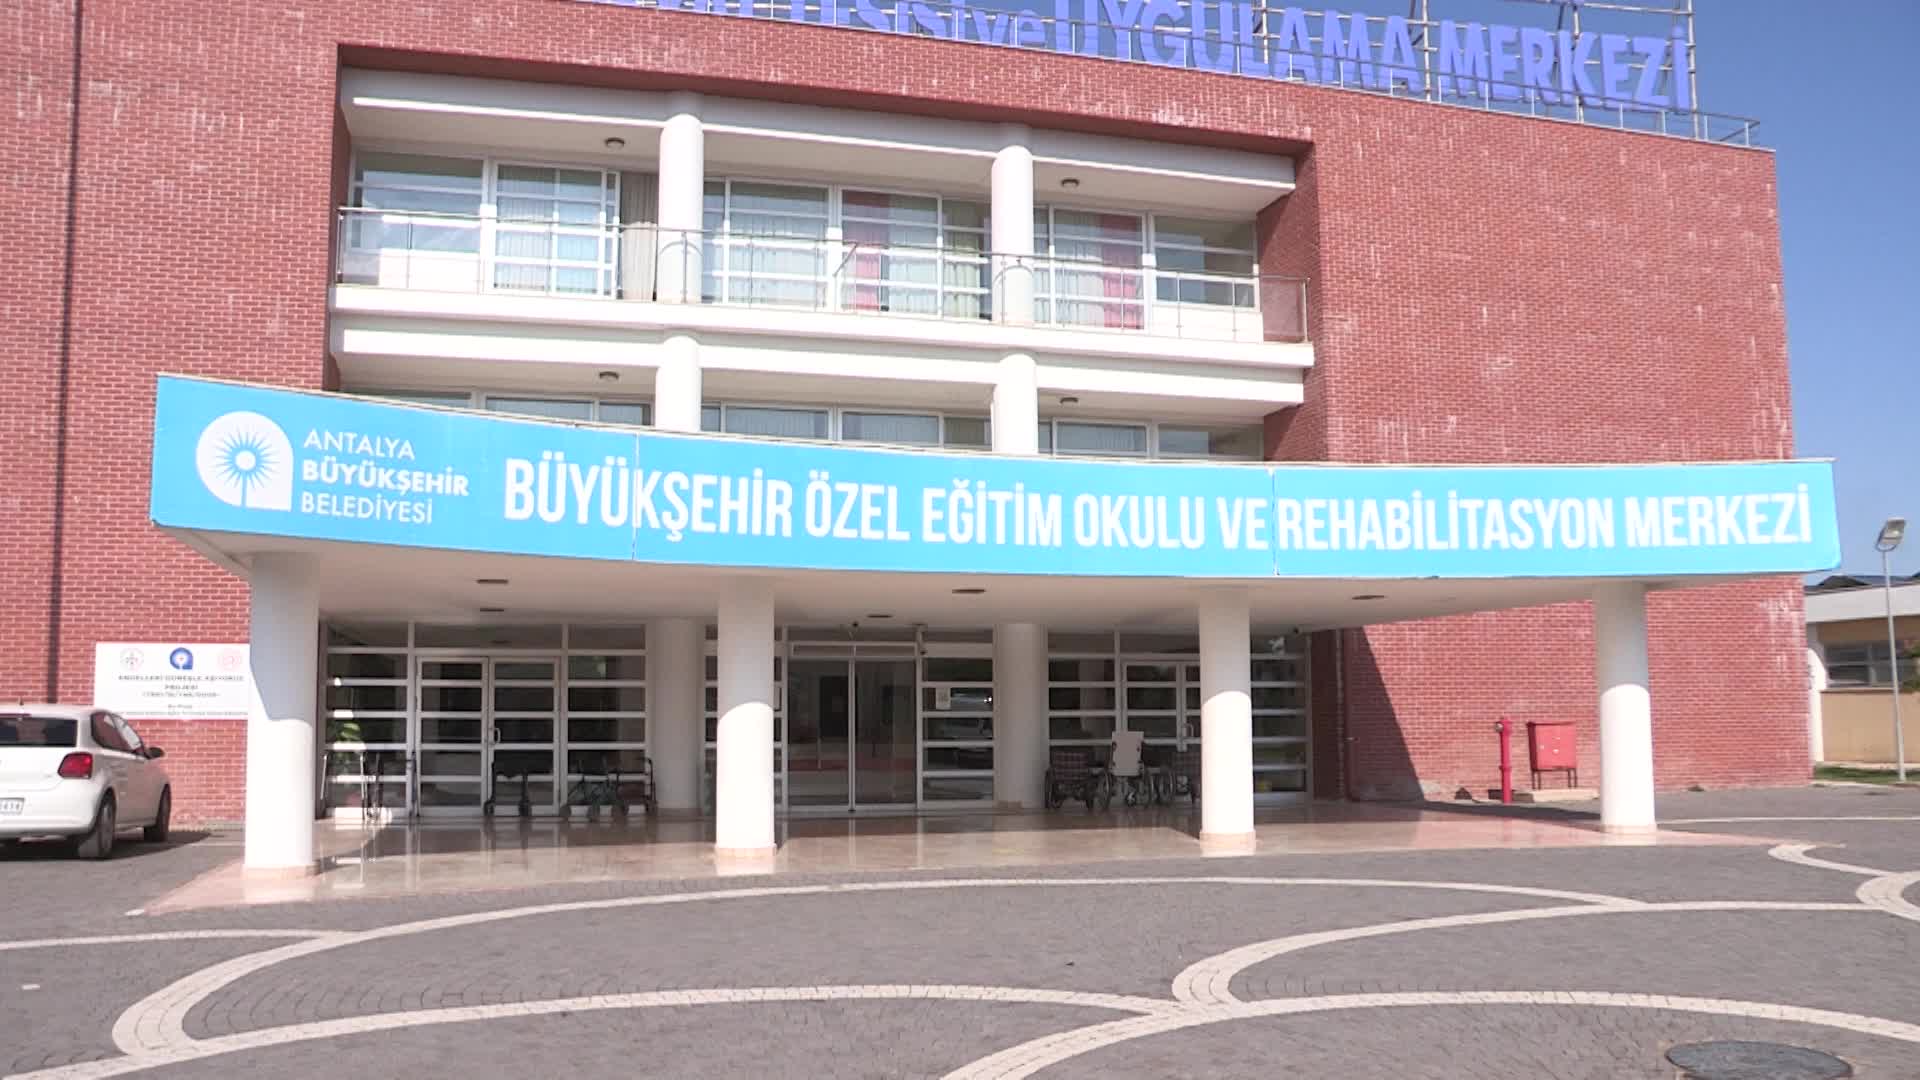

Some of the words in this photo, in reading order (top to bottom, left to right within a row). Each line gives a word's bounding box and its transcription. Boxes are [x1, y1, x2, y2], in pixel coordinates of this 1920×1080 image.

[1438, 20, 1690, 114] MERKEZİ
[303, 428, 415, 460] ANTALYA
[302, 456, 469, 496] BÜYÜKŞEHİR
[301, 491, 433, 524] BELEDİYESİ
[504, 450, 793, 543] BÜYÜKŞEHİR
[805, 469, 911, 542] ÖZEL
[922, 478, 1062, 547] EĞİTİM
[1073, 493, 1205, 550] OKULU
[1216, 496, 1270, 551] VE
[1278, 489, 1616, 551] REHABİLİTASYON
[1625, 483, 1813, 547] MERKEZİ
